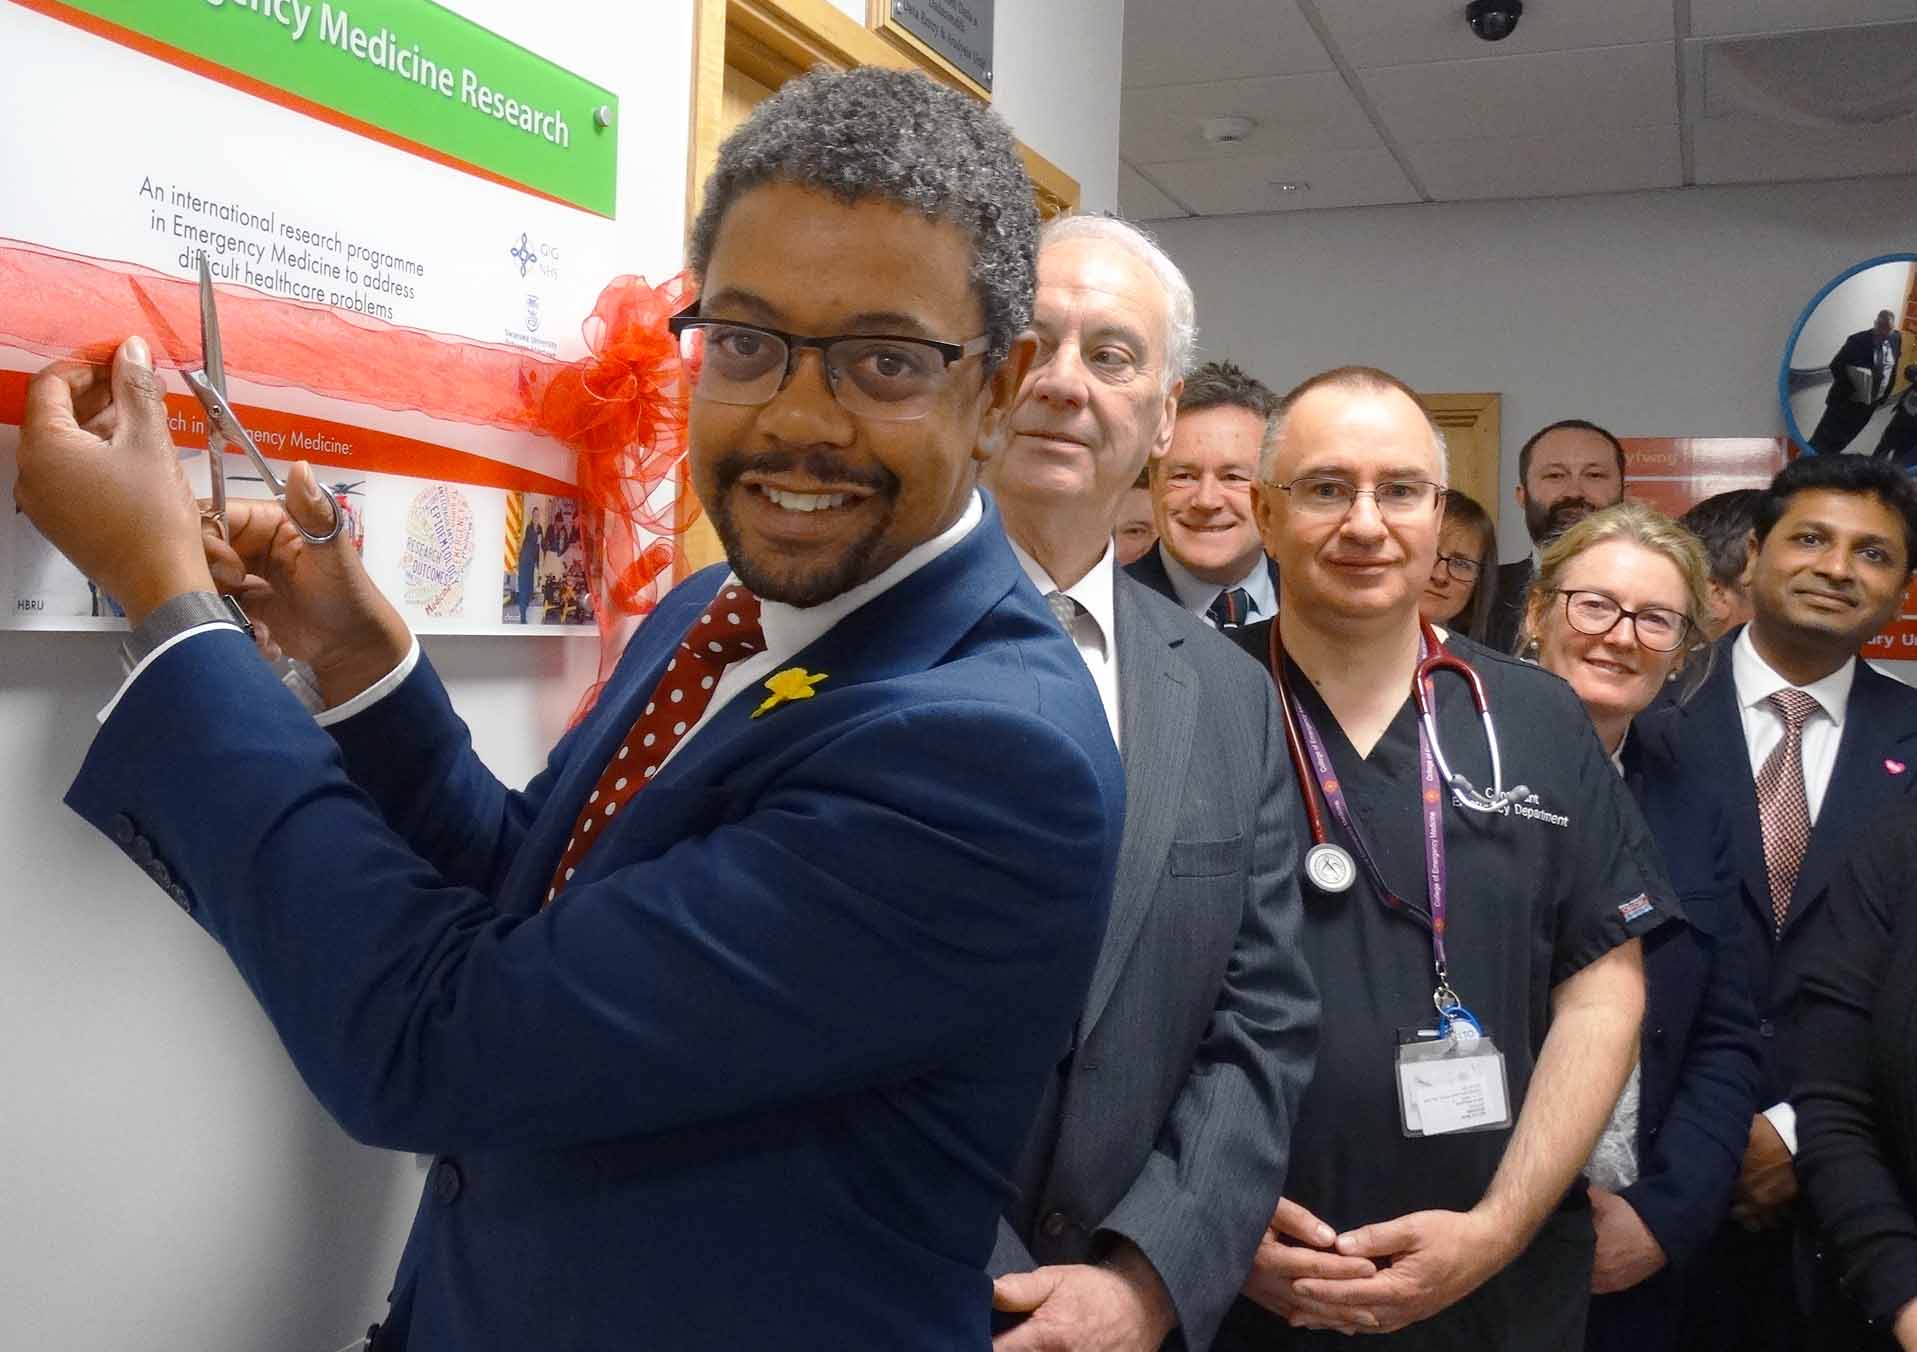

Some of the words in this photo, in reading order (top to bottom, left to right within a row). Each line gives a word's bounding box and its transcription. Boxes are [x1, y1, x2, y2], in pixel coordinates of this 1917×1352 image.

[319, 3, 454, 97] Medicine
[461, 68, 569, 148] Research
[139, 176, 165, 202] An
[171, 185, 275, 233] international
[280, 222, 342, 252] research
[348, 242, 424, 277] programme
[151, 209, 166, 232] in
[173, 214, 266, 264] Emergency
[271, 243, 341, 279] Medicine
[345, 267, 359, 285] to
[363, 271, 415, 300] address
[245, 262, 325, 302] healthcare
[330, 291, 393, 320] problems
[192, 415, 205, 435] in
[290, 430, 353, 456] Medicine:
[1514, 802, 1570, 828] Department
